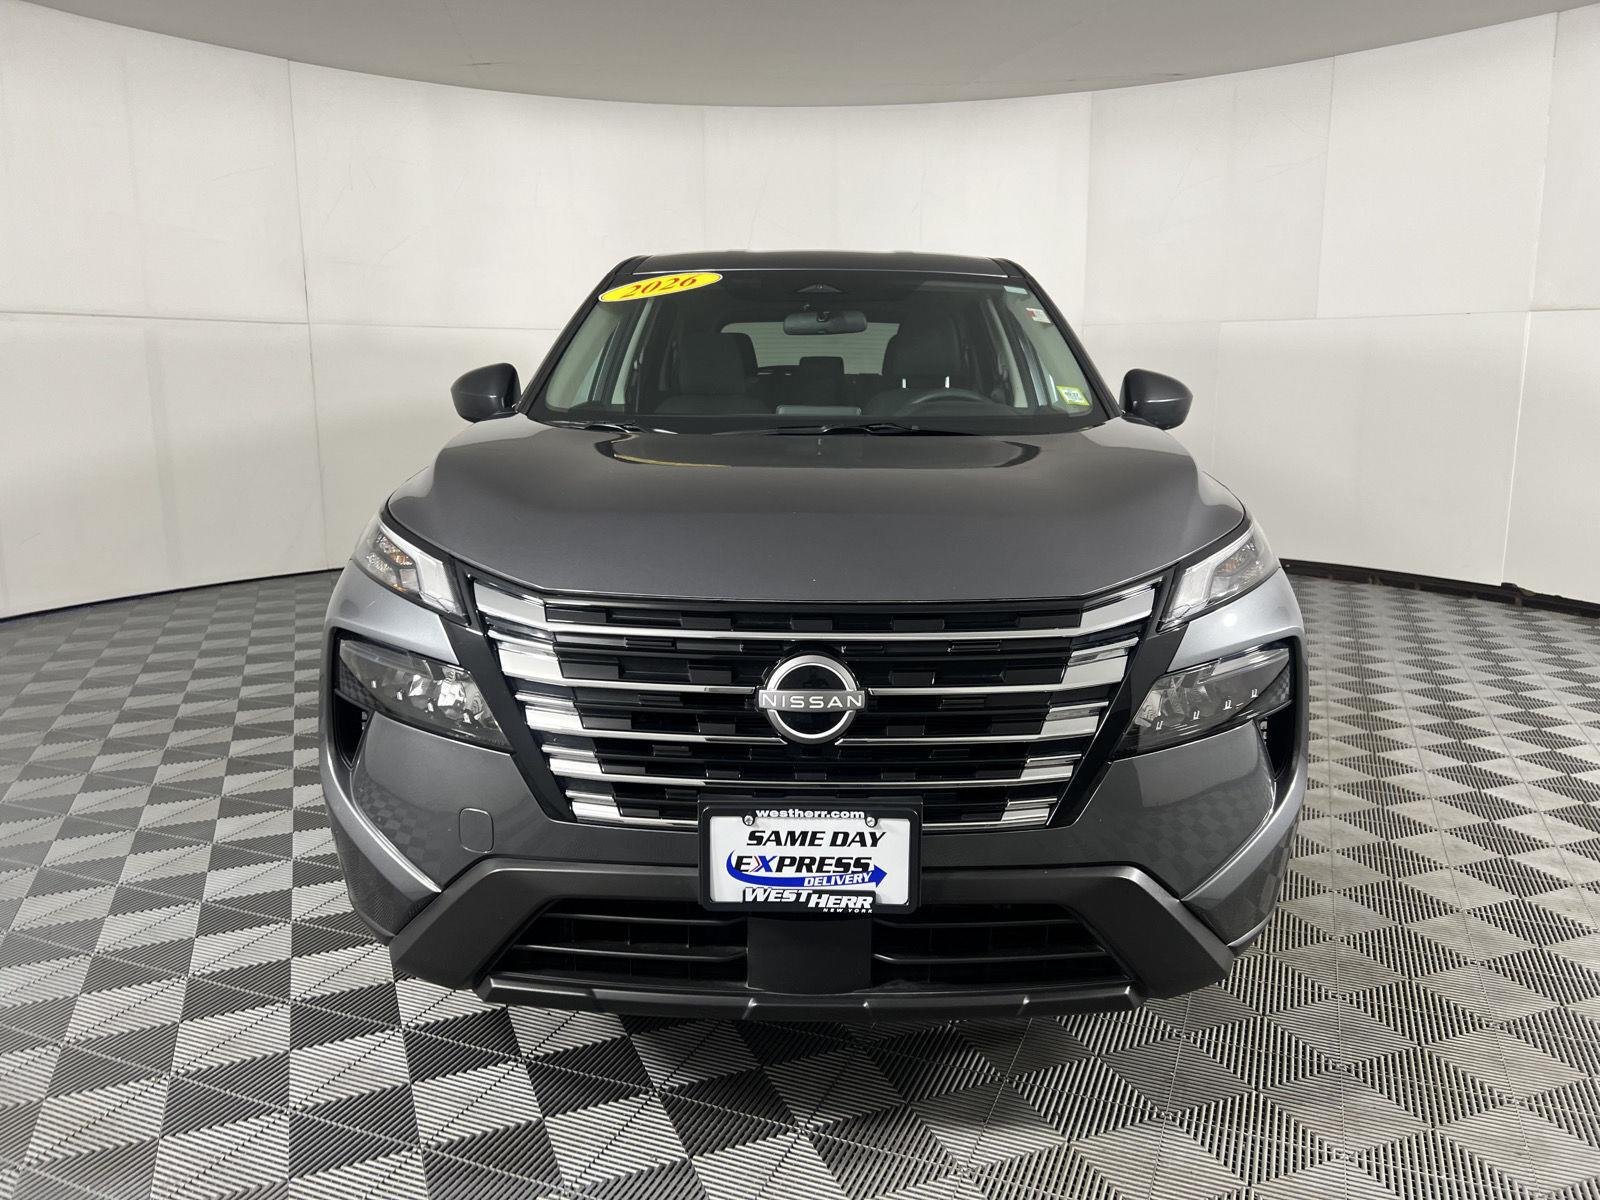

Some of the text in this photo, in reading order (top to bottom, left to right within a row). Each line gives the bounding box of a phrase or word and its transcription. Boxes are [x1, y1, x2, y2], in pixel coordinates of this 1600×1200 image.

[620, 275, 700, 298] 2026
[762, 694, 862, 709] NISSAN
[755, 808, 865, 819] westherr.com
[747, 830, 886, 847] SAME DAY
[735, 855, 872, 873] EXPRESS
[804, 872, 872, 887] DELIVERY
